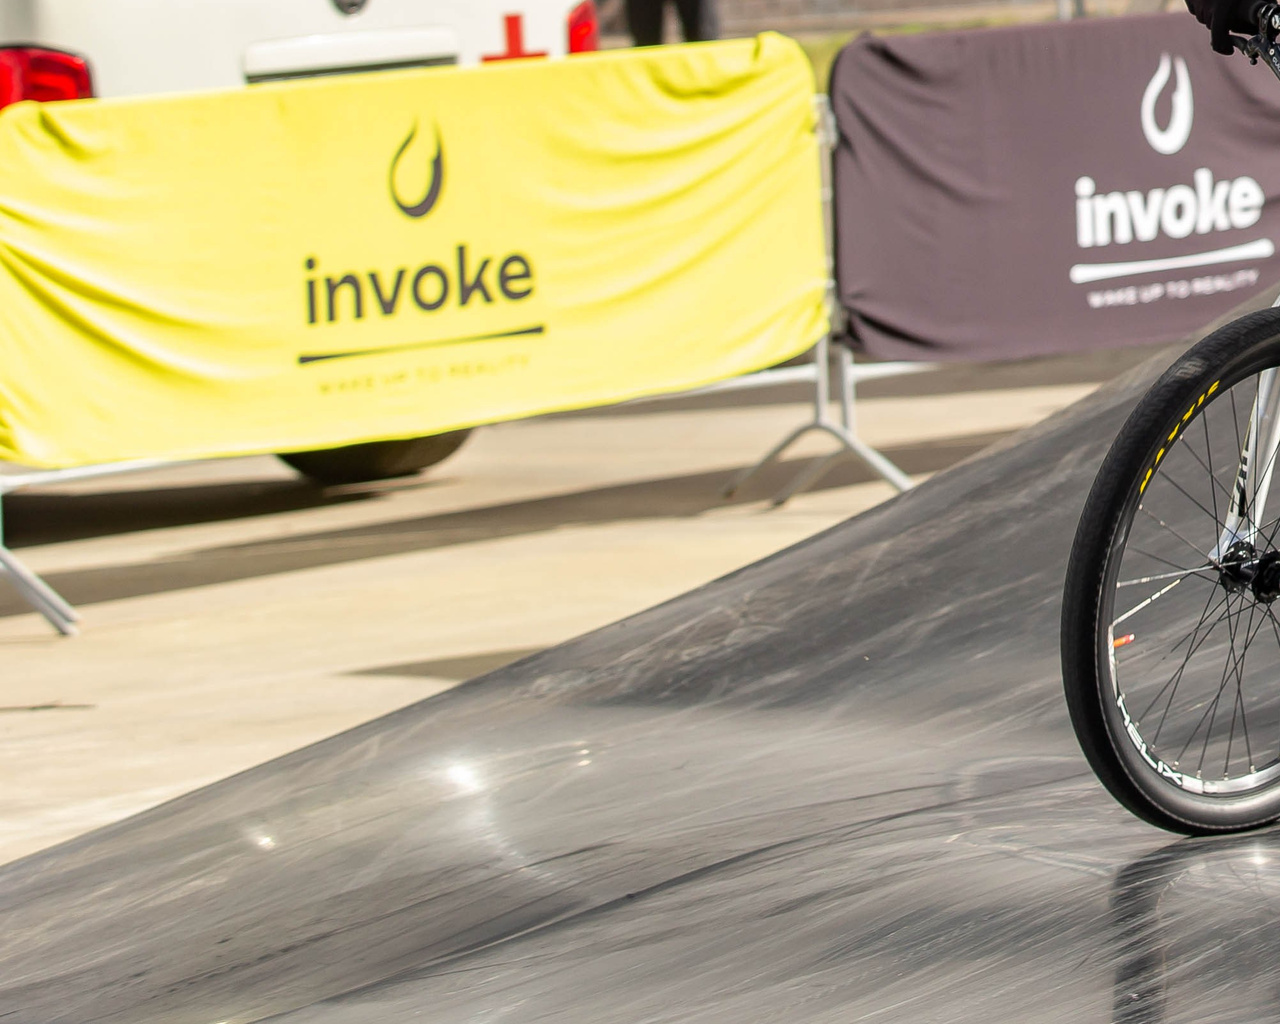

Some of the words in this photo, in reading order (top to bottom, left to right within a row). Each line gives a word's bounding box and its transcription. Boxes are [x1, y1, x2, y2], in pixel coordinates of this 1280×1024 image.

[1074, 167, 1265, 248] invoke
[305, 243, 534, 325] invoke
[1116, 695, 1183, 786] HELIX
